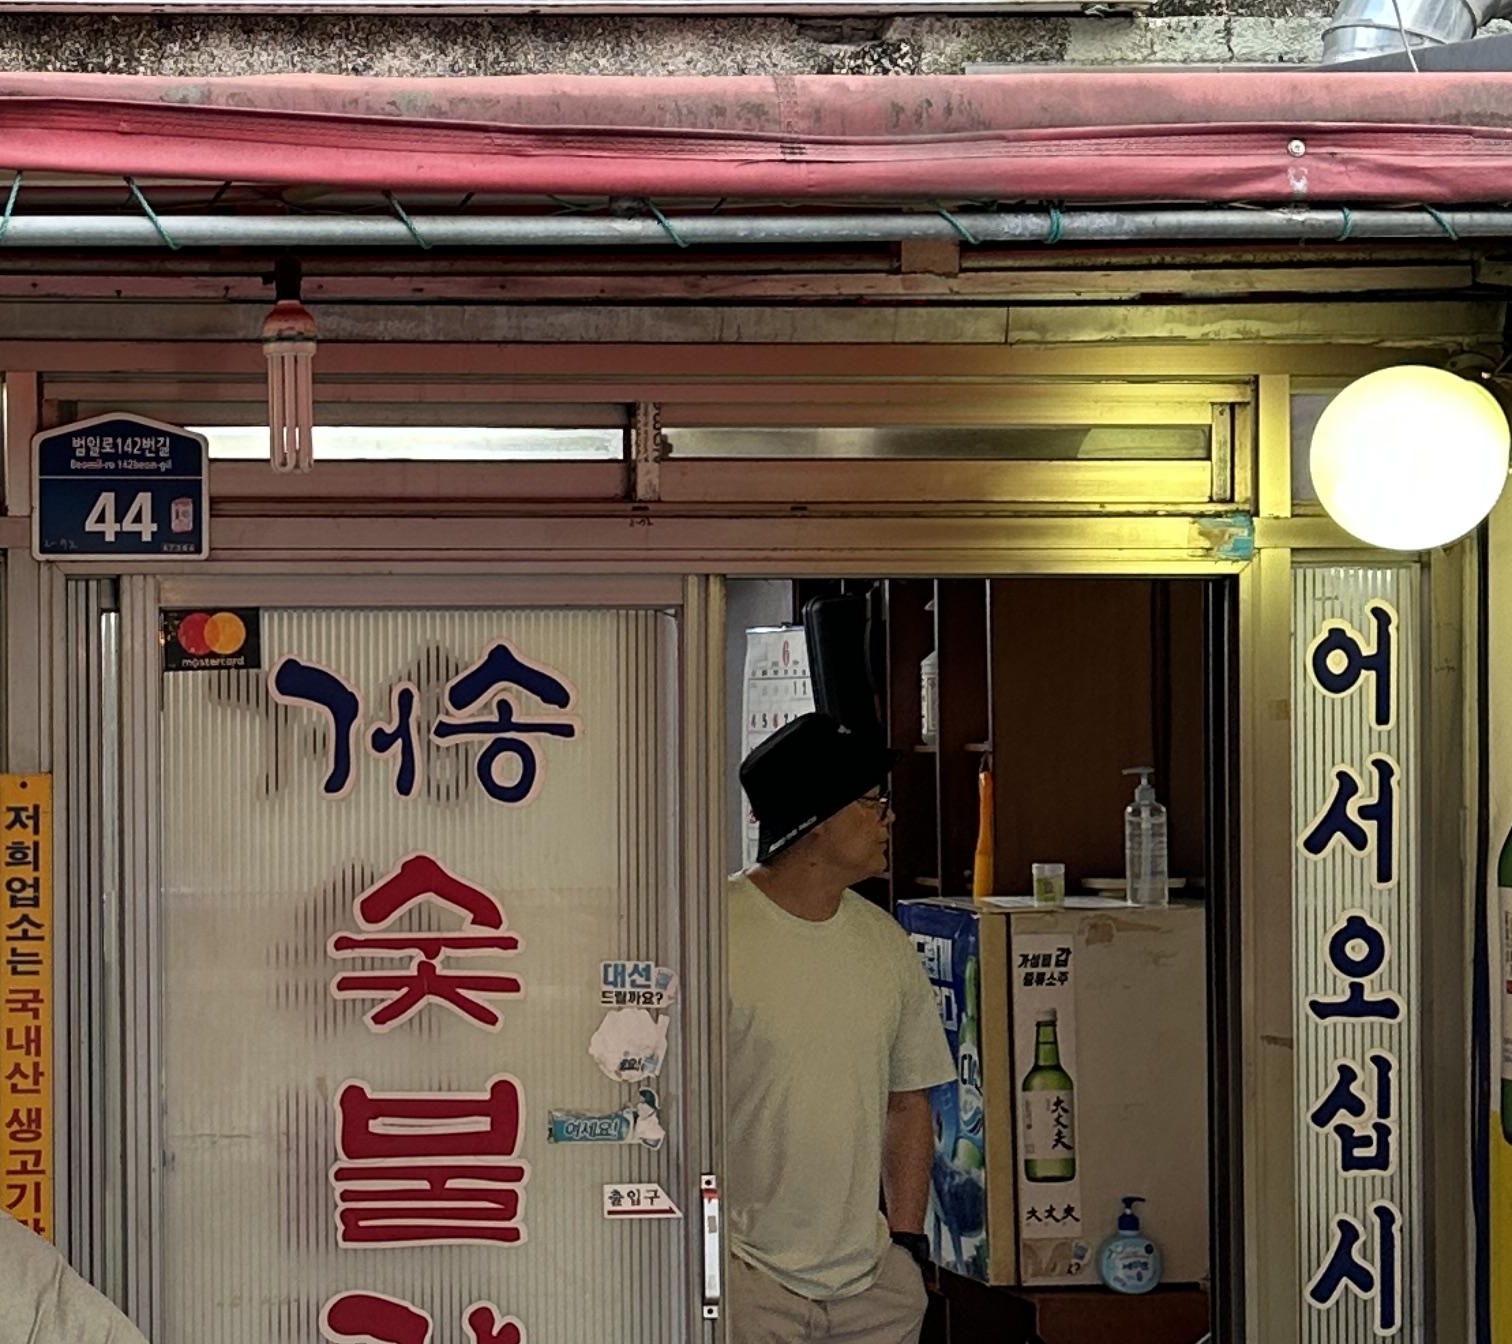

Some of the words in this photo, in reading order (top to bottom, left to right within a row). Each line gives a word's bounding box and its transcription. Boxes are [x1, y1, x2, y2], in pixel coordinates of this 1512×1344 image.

[84, 491, 158, 542] 44
[181, 656, 245, 668] mastercard
[275, 644, 577, 804] 거송
[603, 963, 652, 989] 대선
[4, 987, 46, 1095] 국내산
[608, 1189, 660, 1206] 출입구
